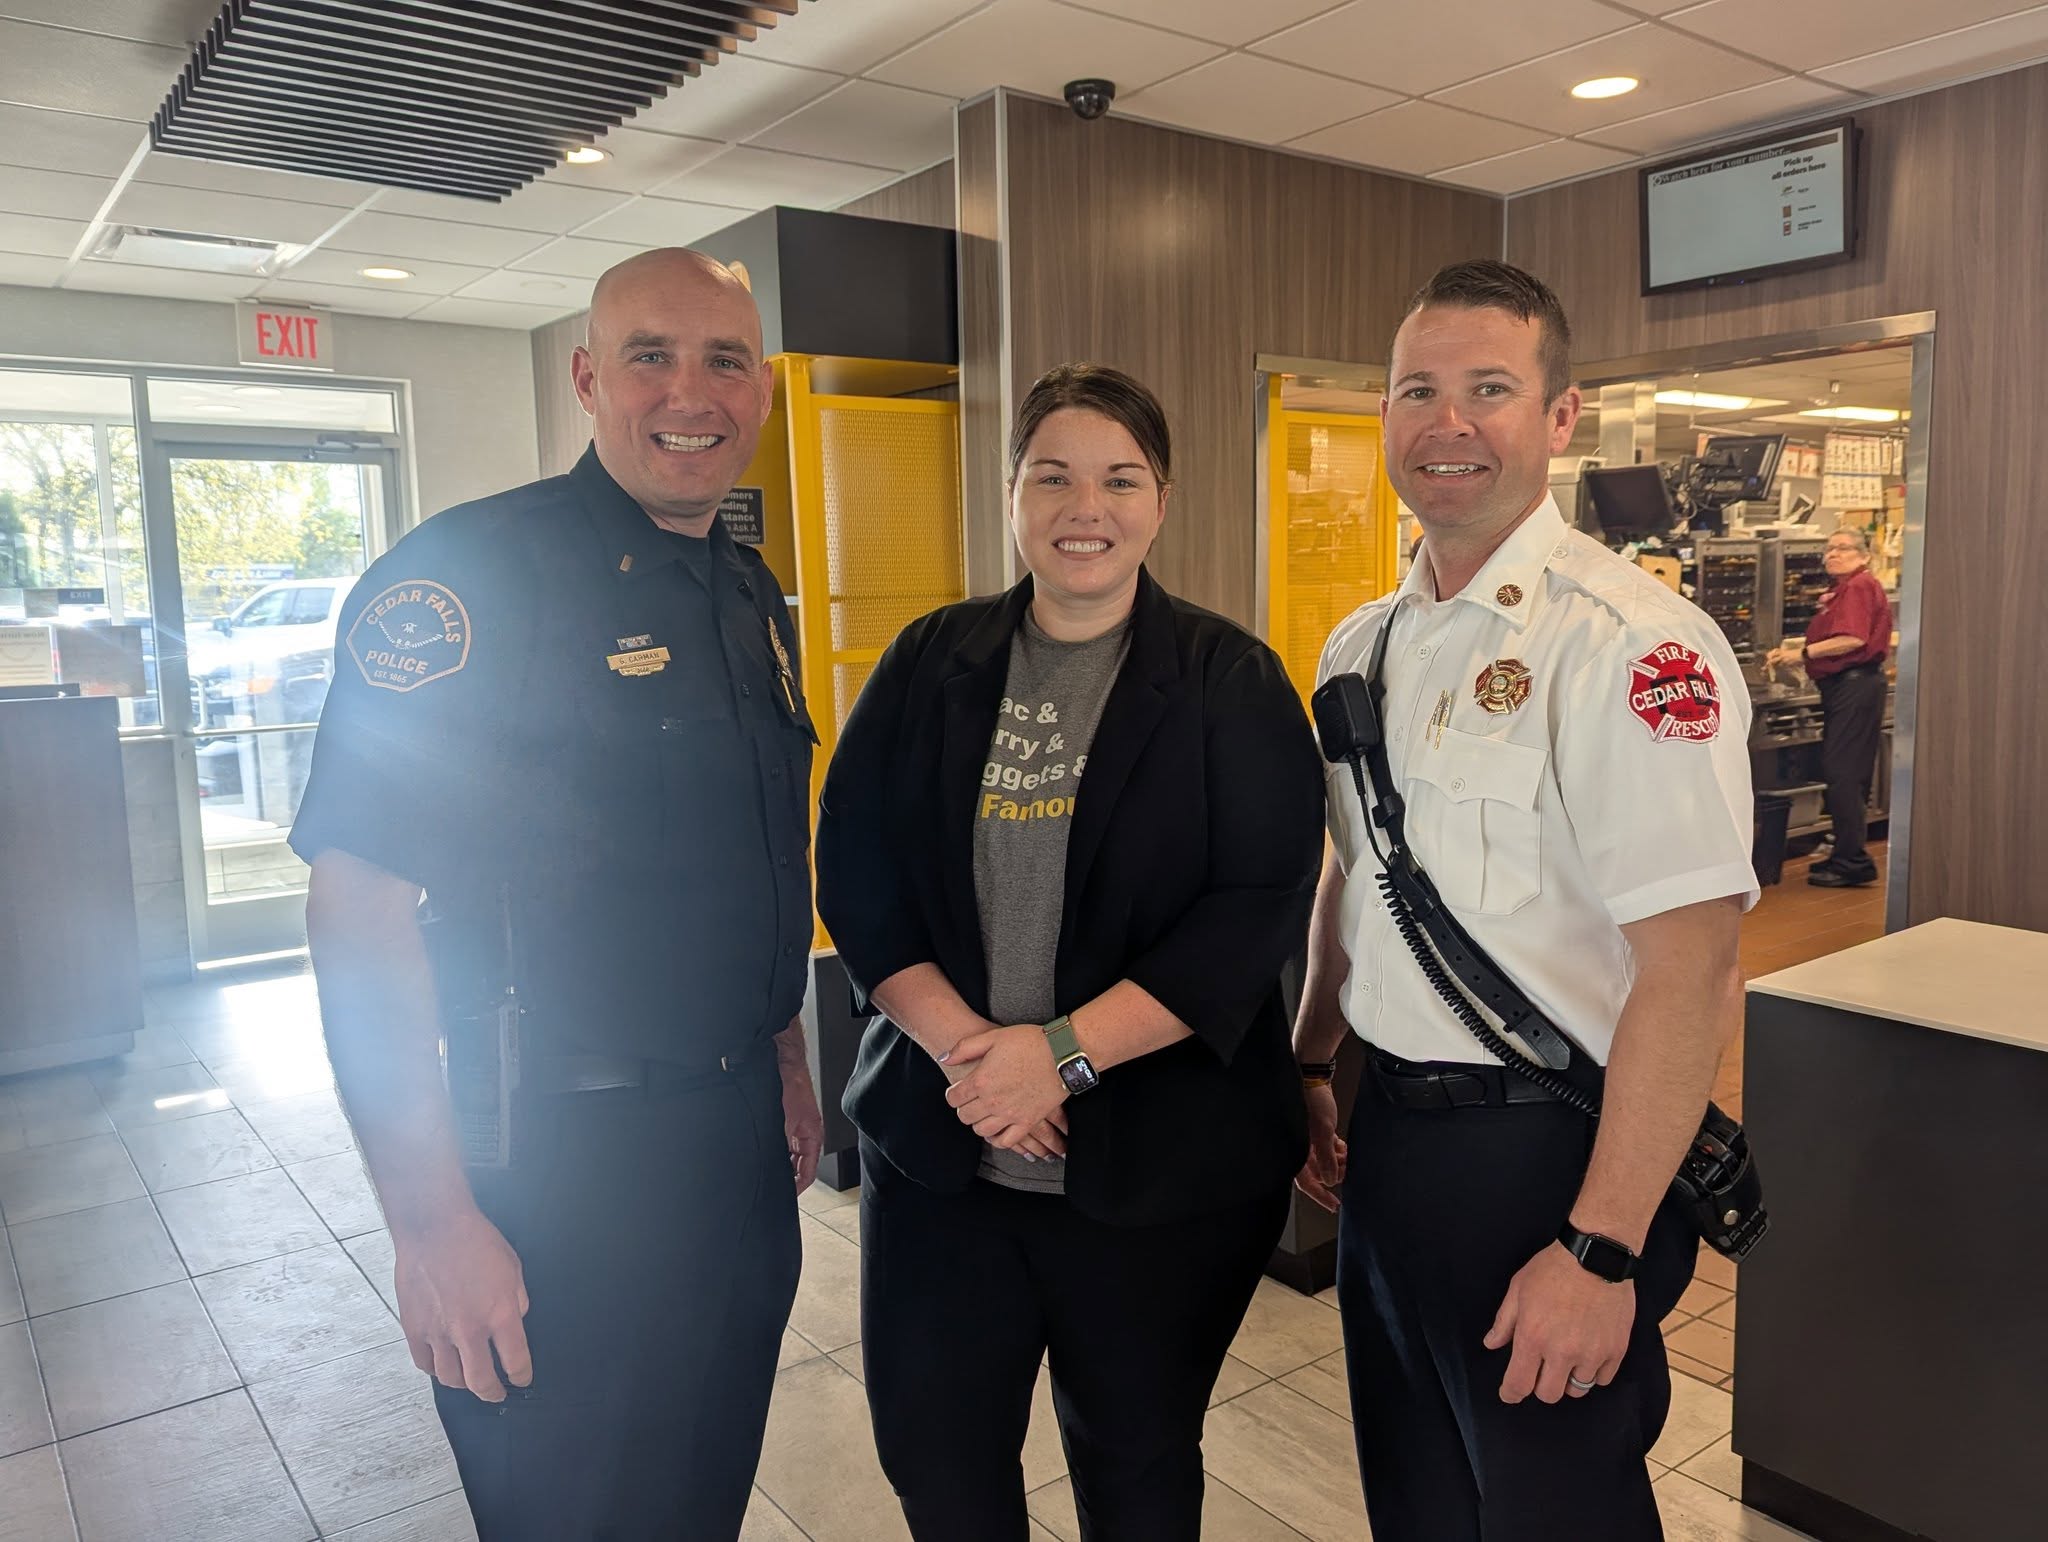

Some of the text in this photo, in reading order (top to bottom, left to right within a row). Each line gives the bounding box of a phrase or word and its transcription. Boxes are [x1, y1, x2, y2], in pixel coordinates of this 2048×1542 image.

[1661, 169, 1689, 183] Watch
[1690, 166, 1710, 177] here
[1711, 161, 1724, 172] for
[1772, 163, 1826, 180] all orders here
[1783, 155, 1814, 167] Pick up
[256, 312, 318, 360] EXIT
[728, 492, 754, 500] mers
[366, 589, 461, 643] CEDAR FALLS
[365, 650, 429, 675] POLICE
[628, 652, 660, 664] CARMAN
[1654, 645, 1691, 664] FIRE
[1632, 681, 1691, 711] CEDAR
[1036, 702, 1059, 723] &
[994, 728, 1065, 760] rry &
[981, 761, 1066, 791] ggets
